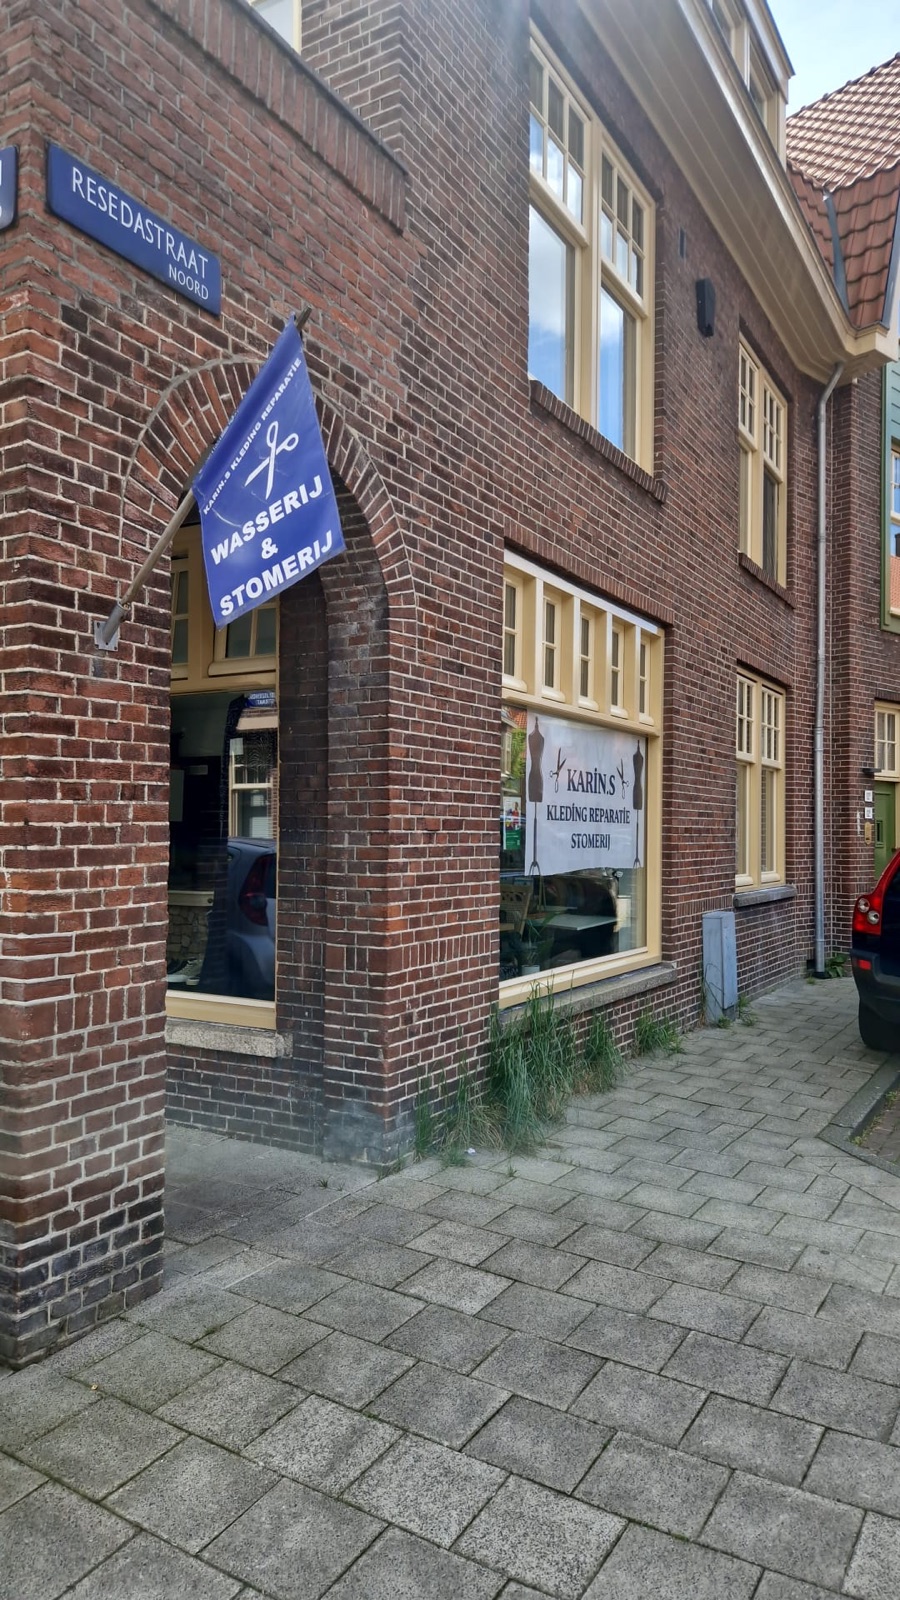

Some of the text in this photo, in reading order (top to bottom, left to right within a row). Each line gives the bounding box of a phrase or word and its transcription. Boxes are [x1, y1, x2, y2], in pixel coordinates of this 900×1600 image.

[72, 166, 208, 279] RESEDASTRAAT
[168, 263, 209, 300] NOORD
[210, 474, 323, 566] WASSERIJ
[261, 537, 279, 560] &
[219, 529, 333, 617] STOMERIJ
[571, 833, 611, 851] STOMERIJ
